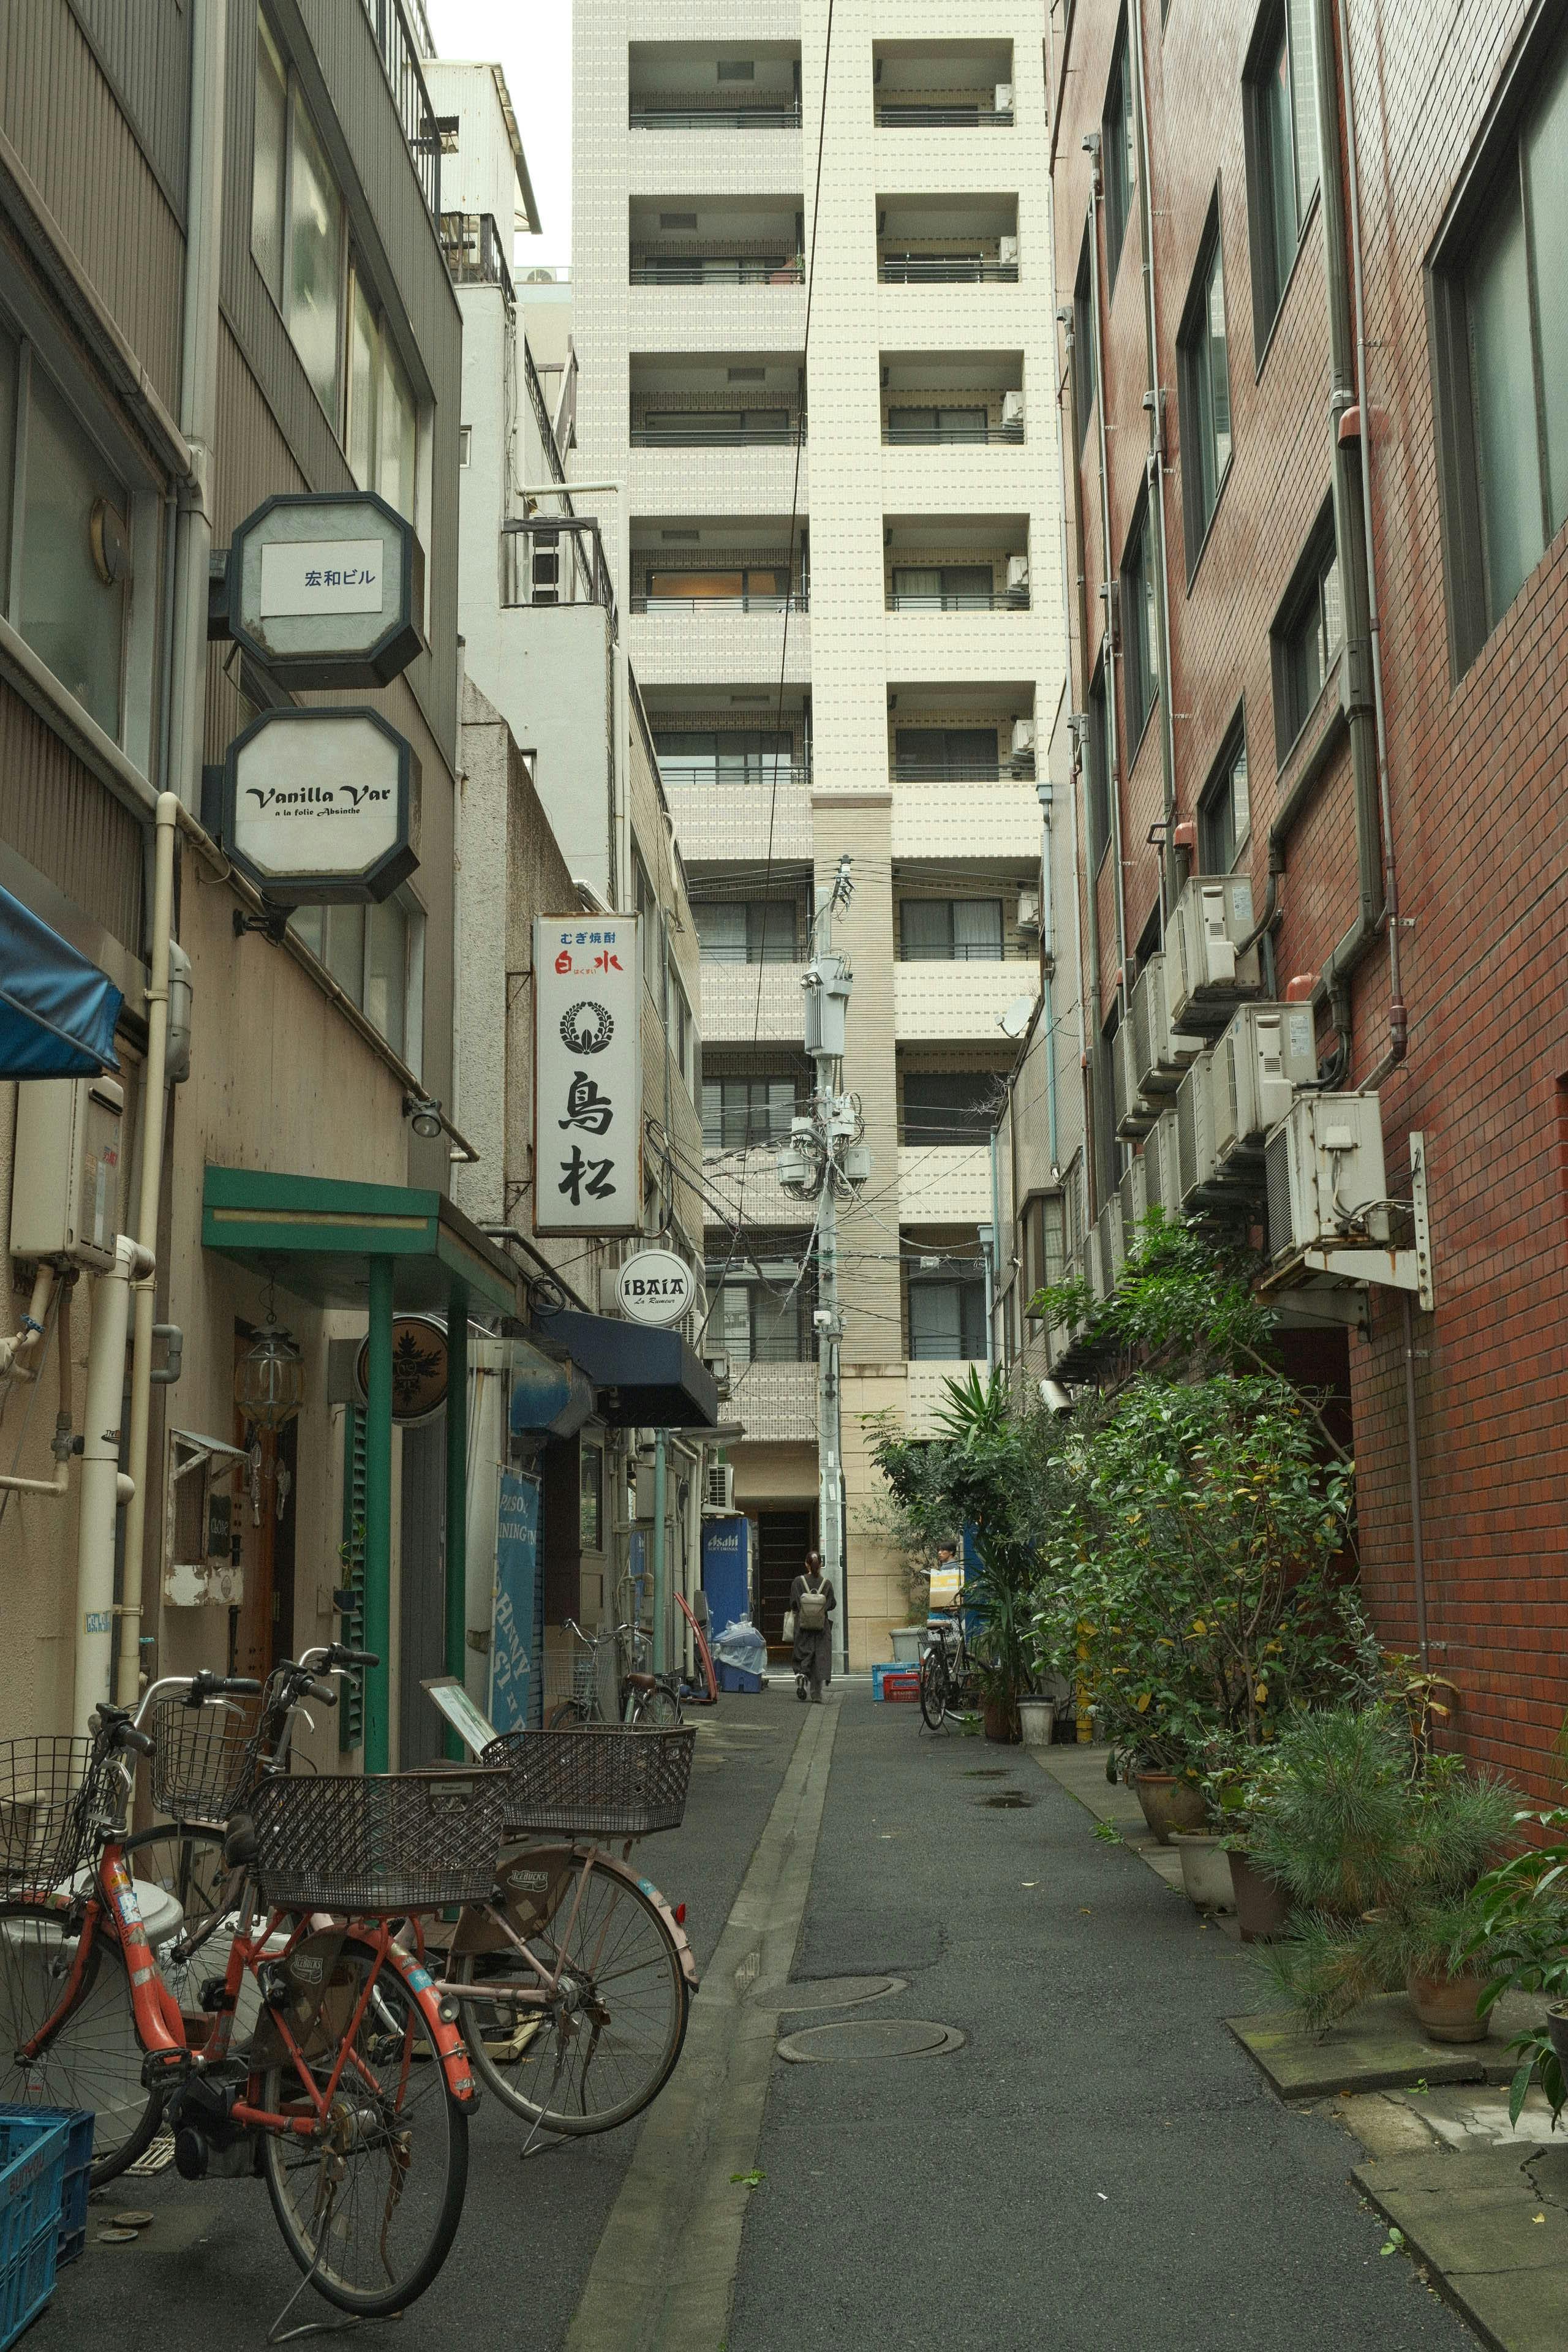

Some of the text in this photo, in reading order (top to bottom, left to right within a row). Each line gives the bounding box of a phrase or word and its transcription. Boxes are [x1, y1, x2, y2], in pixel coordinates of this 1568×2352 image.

[305, 569, 375, 586] 宏和ビル
[246, 785, 390, 809] Vanilla Var
[317, 808, 360, 816] Absinthe
[560, 932, 616, 944] むぎ焼酎
[558, 1071, 616, 1206] 鳥松
[708, 1534, 739, 1547] Asahi
